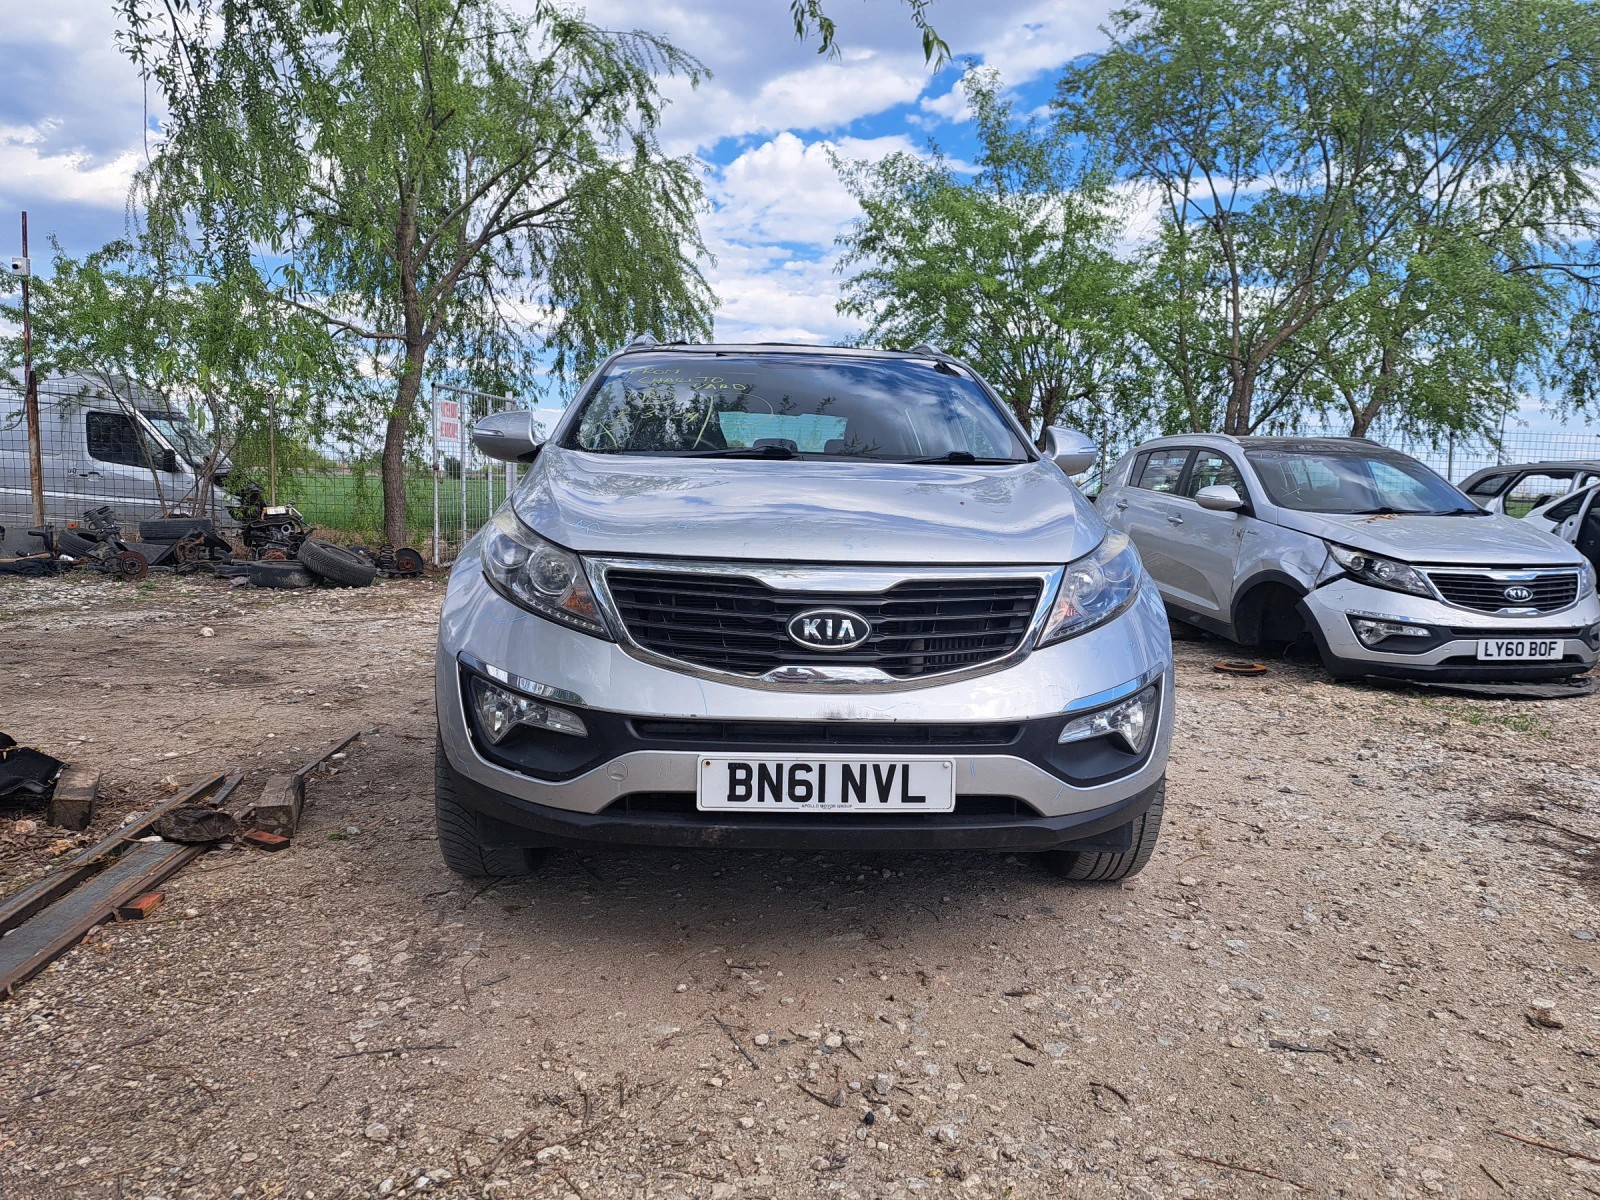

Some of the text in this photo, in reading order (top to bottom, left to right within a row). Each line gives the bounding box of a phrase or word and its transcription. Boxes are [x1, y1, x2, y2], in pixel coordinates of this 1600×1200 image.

[1509, 589, 1529, 598] KIA
[802, 618, 857, 640] KIA
[1484, 641, 1558, 657] LY60 BOF
[727, 762, 926, 804] BN61 NVL
